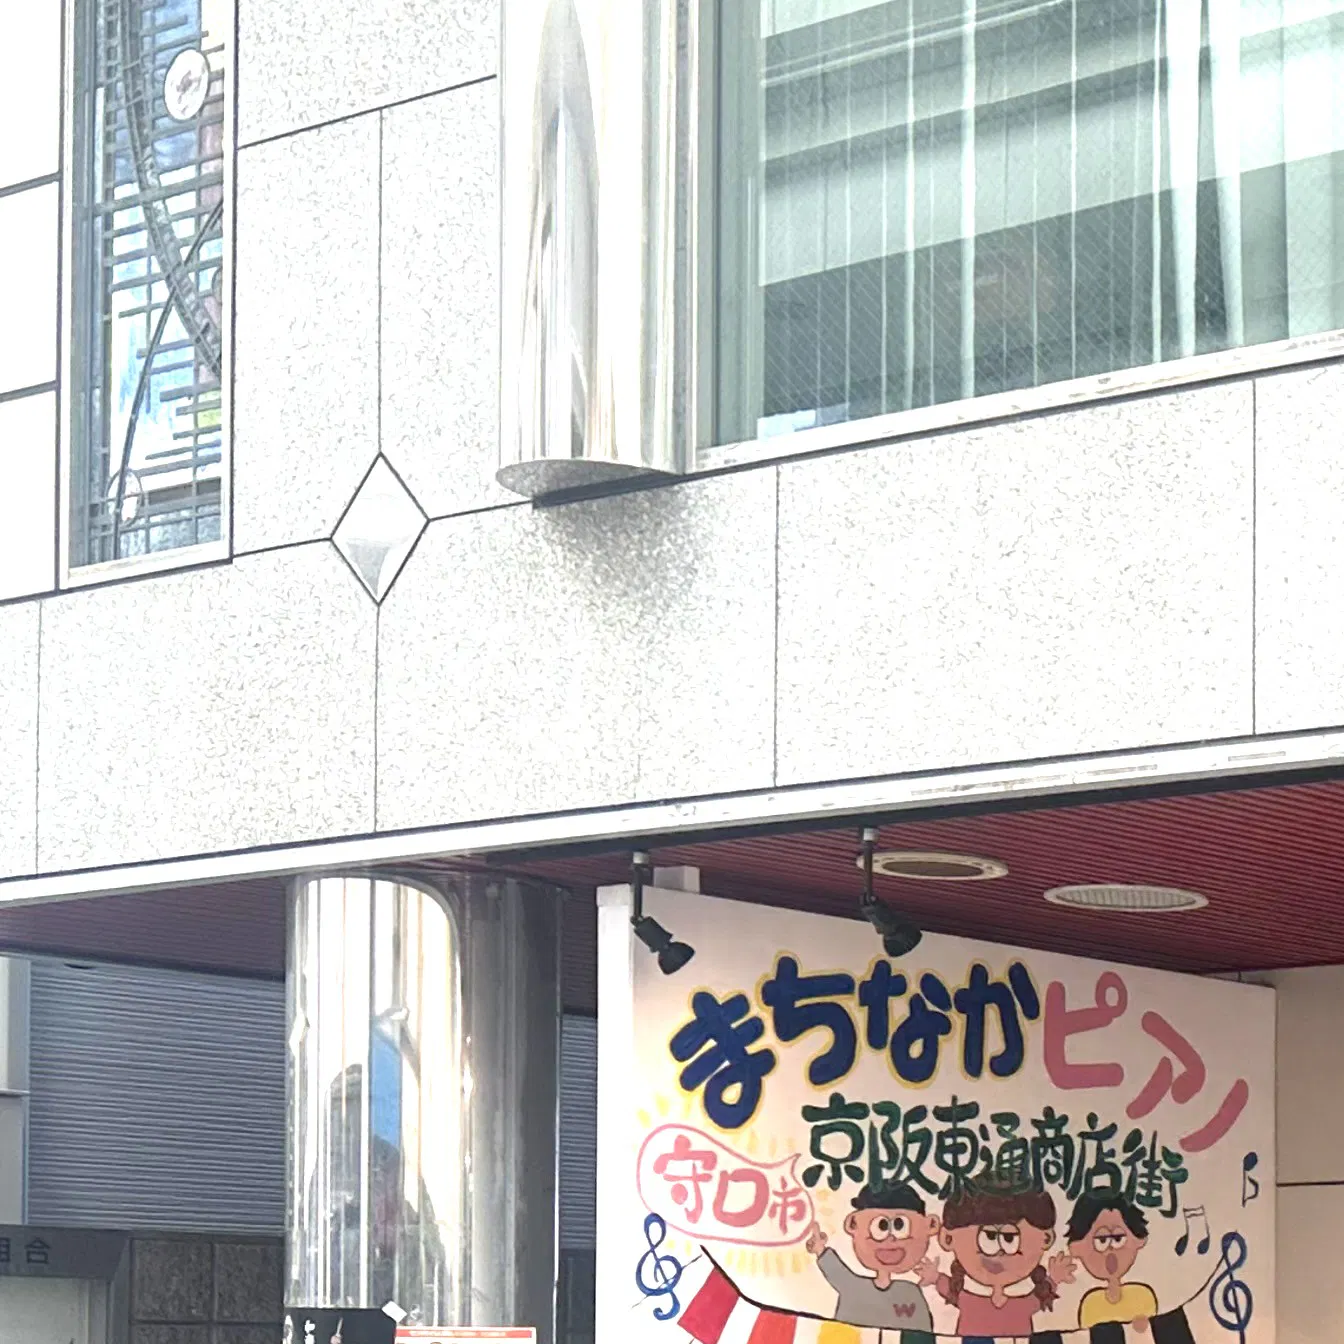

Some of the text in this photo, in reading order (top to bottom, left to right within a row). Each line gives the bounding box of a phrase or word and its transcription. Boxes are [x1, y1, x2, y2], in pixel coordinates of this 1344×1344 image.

[670, 955, 1250, 1154] まちなかピアノ
[653, 1134, 808, 1232] 守口市
[800, 1093, 1189, 1219] 京阪東通商店街
